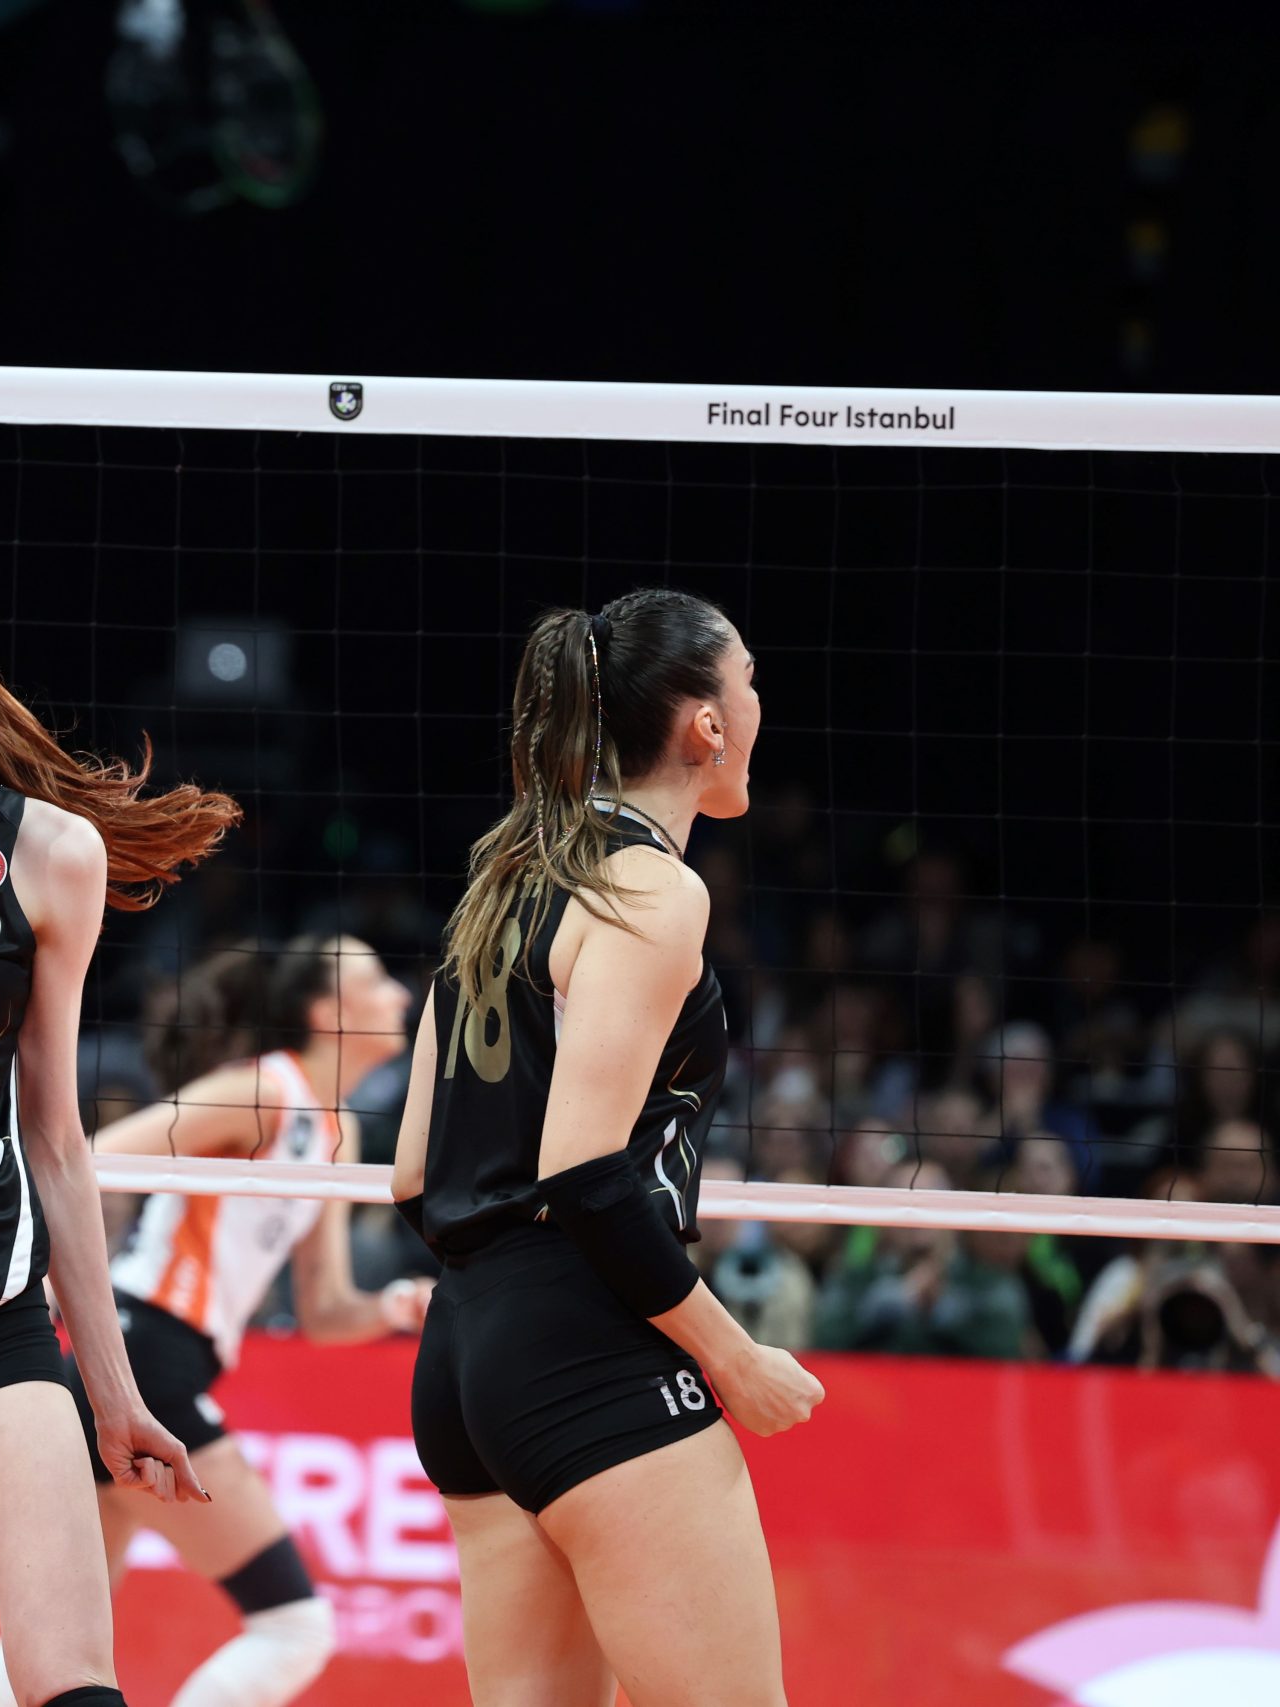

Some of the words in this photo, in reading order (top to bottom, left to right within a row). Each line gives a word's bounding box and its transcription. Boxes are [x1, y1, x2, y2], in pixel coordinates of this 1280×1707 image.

[708, 402, 770, 426] Final
[780, 404, 838, 427] Four
[847, 405, 955, 430] Istanbul
[657, 1369, 706, 1416] 18
